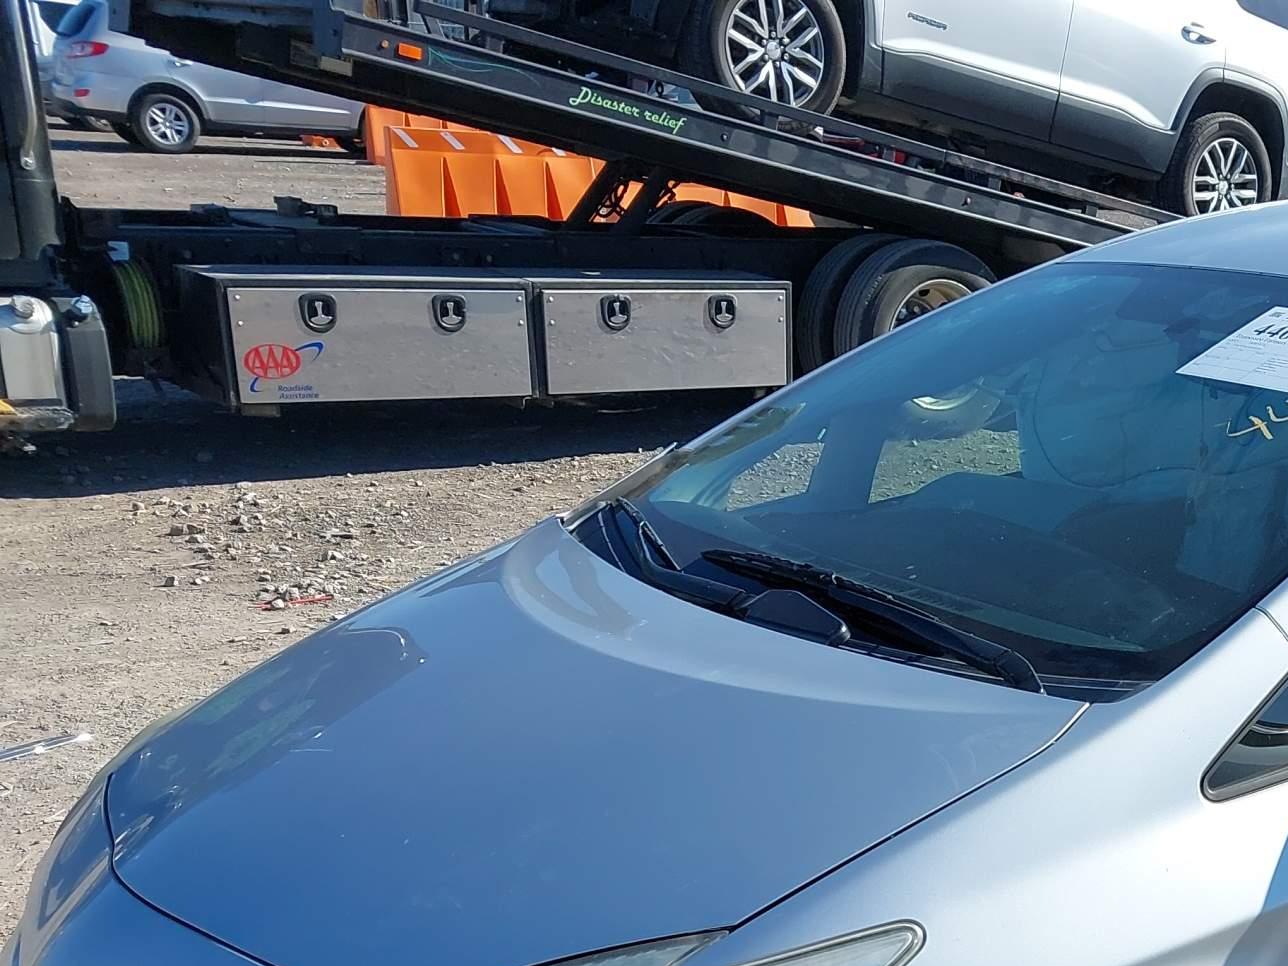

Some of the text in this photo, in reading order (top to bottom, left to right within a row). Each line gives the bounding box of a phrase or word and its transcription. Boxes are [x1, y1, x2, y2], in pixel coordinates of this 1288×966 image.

[568, 85, 688, 135] Disaster relief
[249, 345, 299, 378] AAA
